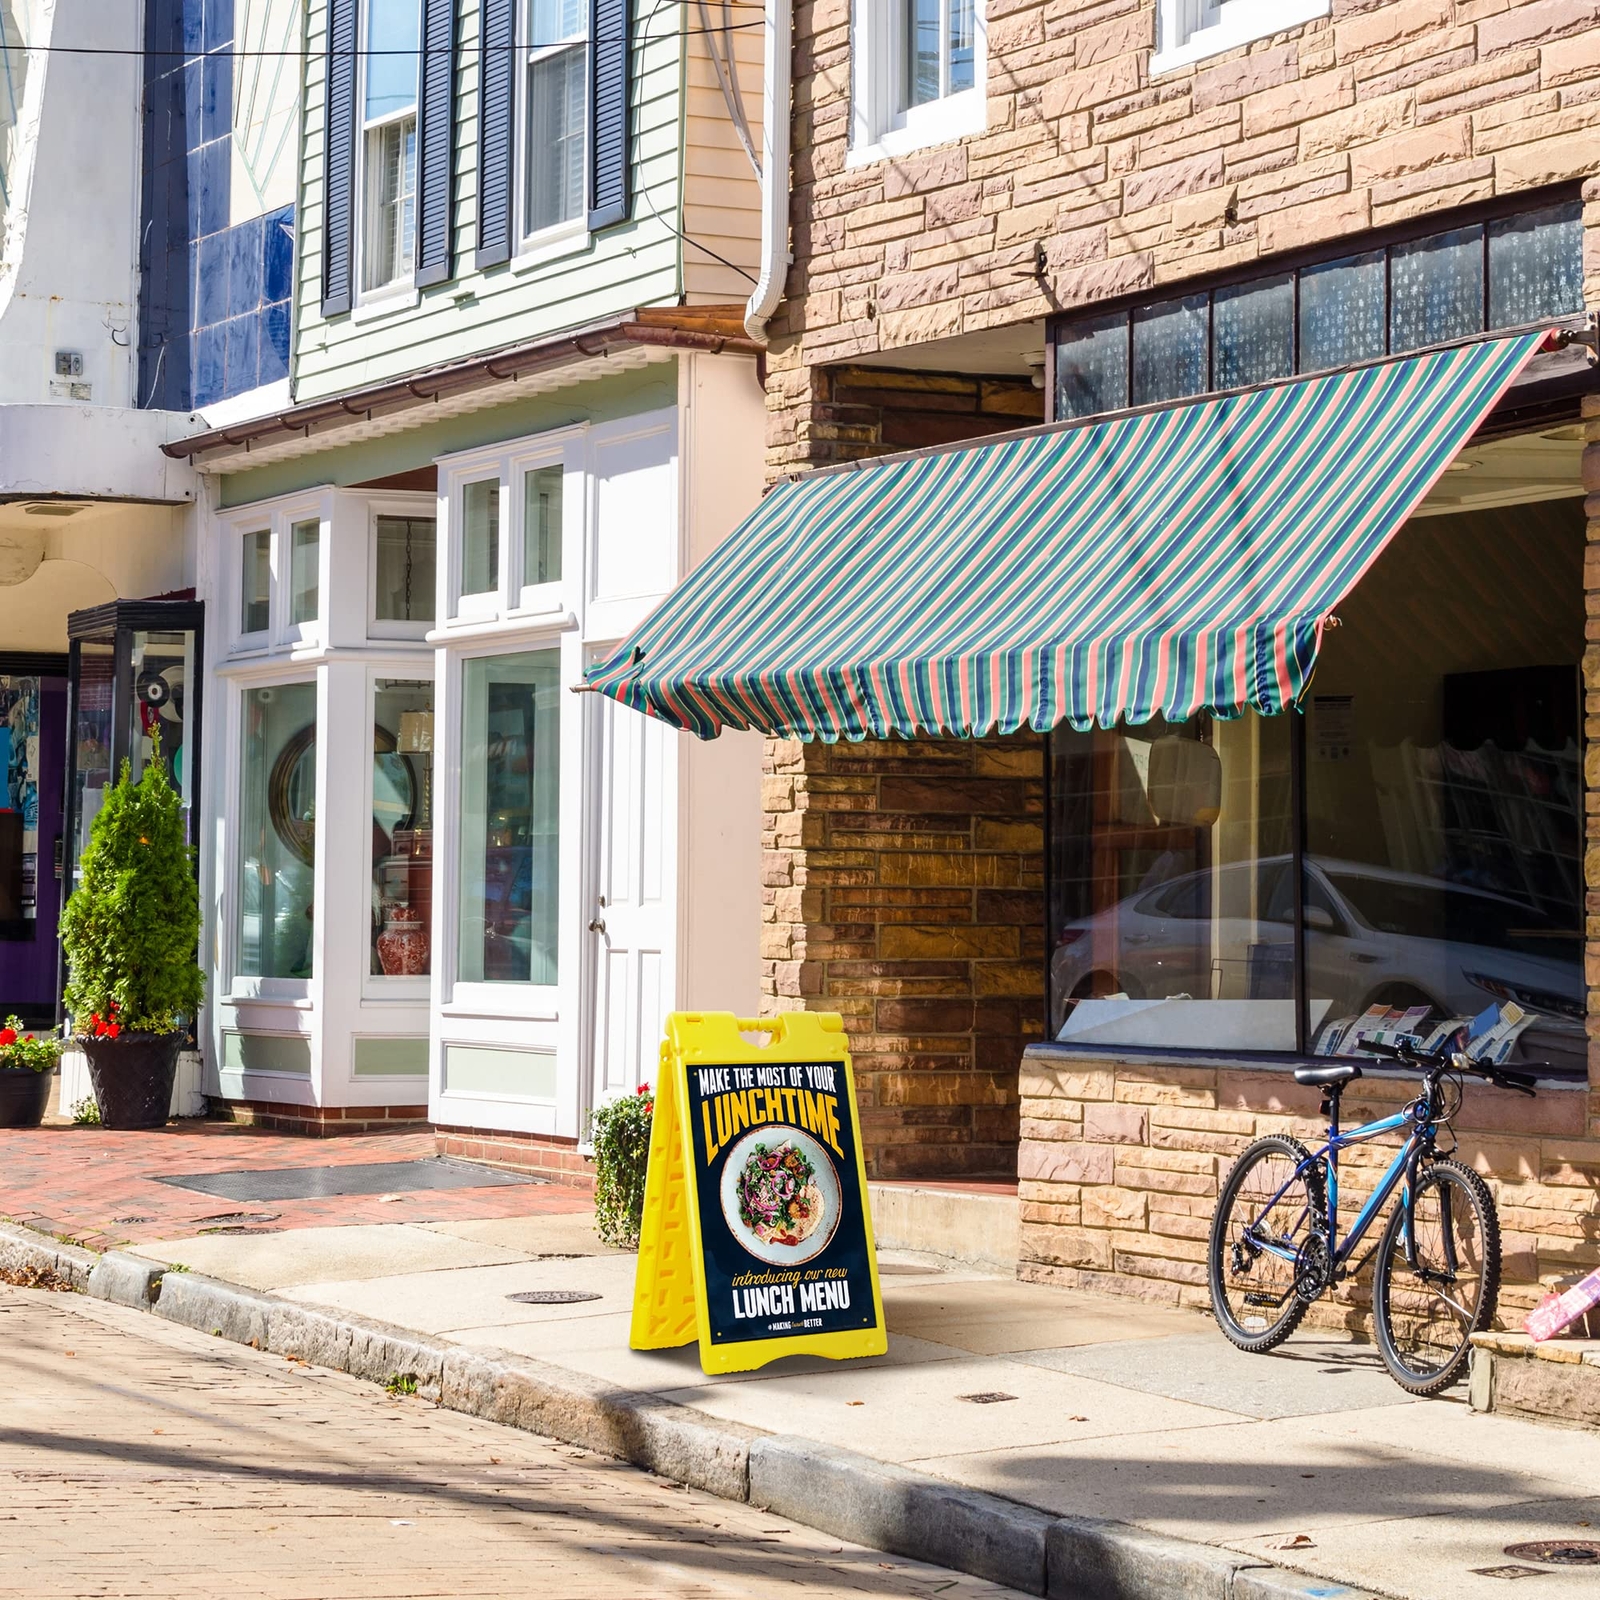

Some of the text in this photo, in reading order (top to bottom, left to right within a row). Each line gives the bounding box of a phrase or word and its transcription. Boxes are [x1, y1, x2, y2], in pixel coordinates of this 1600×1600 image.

[698, 1065, 836, 1097] MAKE THE MOST OF YOUR
[702, 1088, 845, 1166] LUNCHTIME
[732, 1268, 848, 1289] introducing our new
[732, 1280, 850, 1319] LUNCH MENU
[803, 1318, 823, 1328] BETTER
